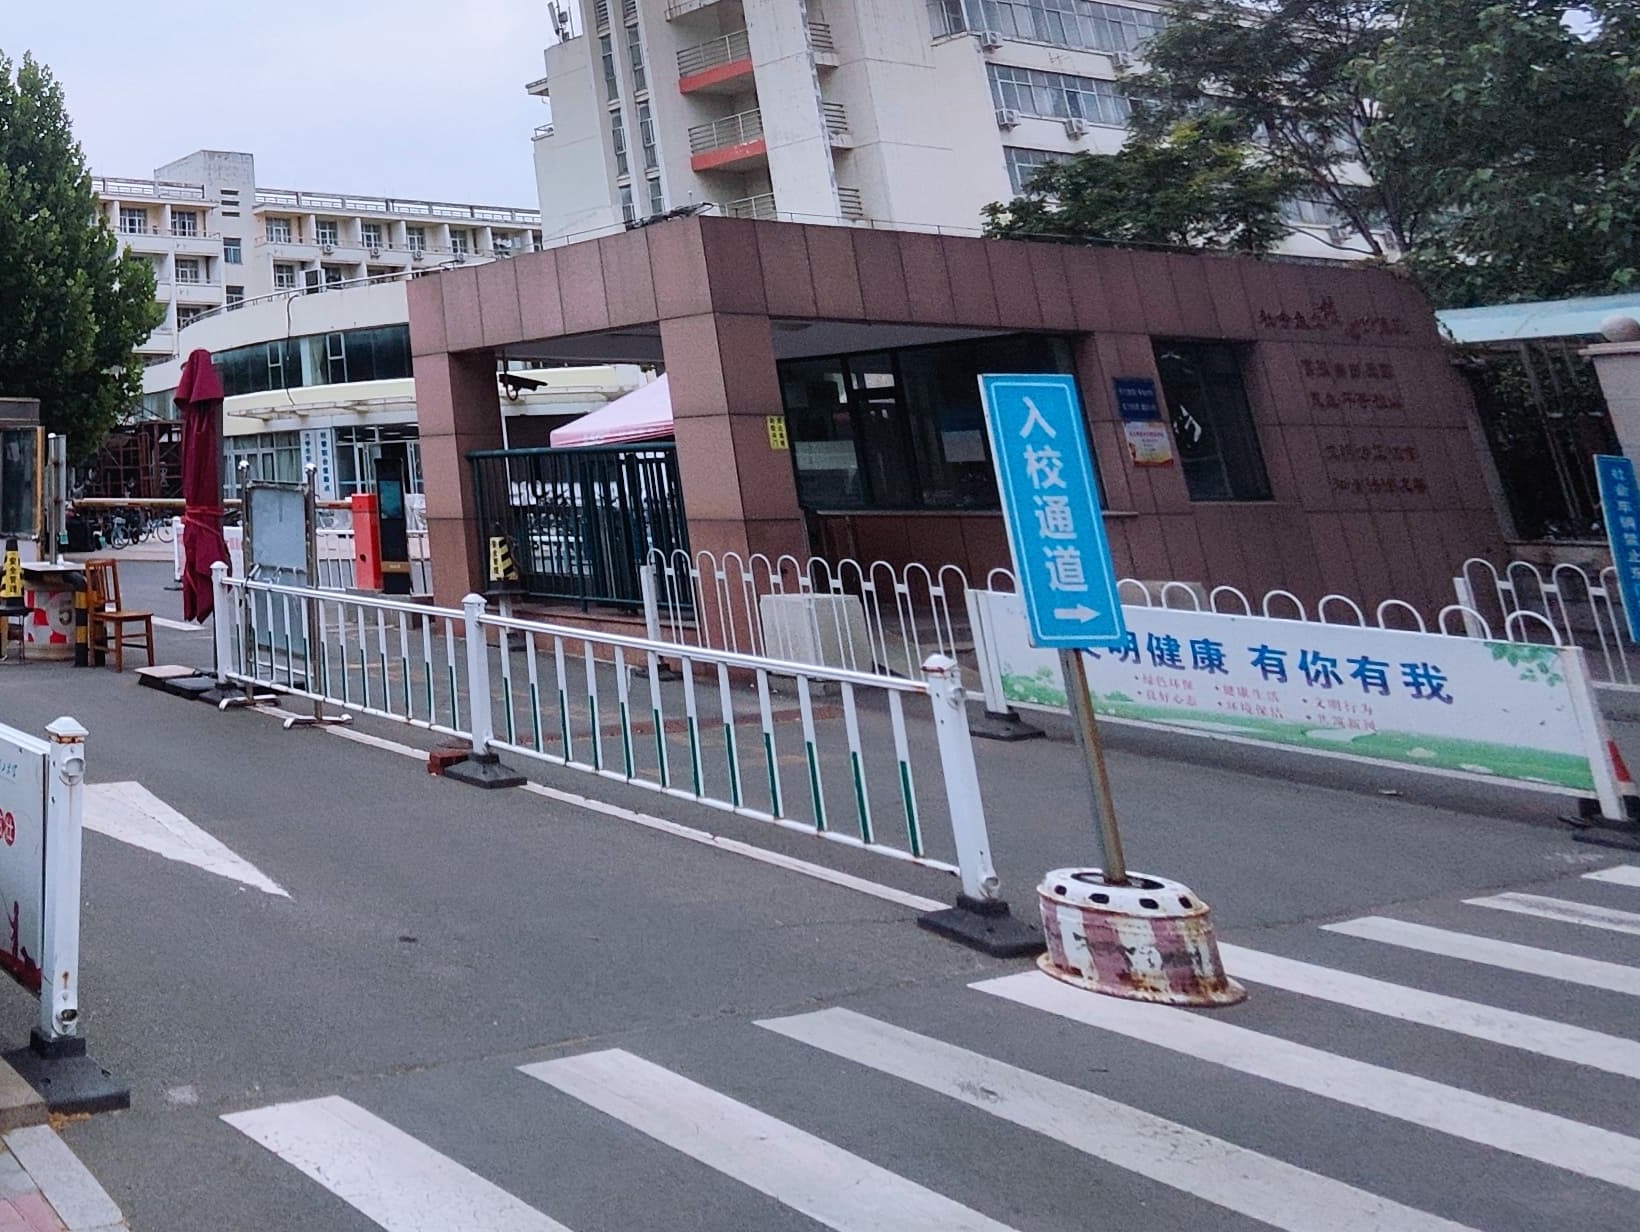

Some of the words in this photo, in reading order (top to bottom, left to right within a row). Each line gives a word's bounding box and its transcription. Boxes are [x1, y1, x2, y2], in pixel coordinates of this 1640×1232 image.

[1019, 396, 1089, 592] 入校通道
[1247, 643, 1454, 705] 有你有我
